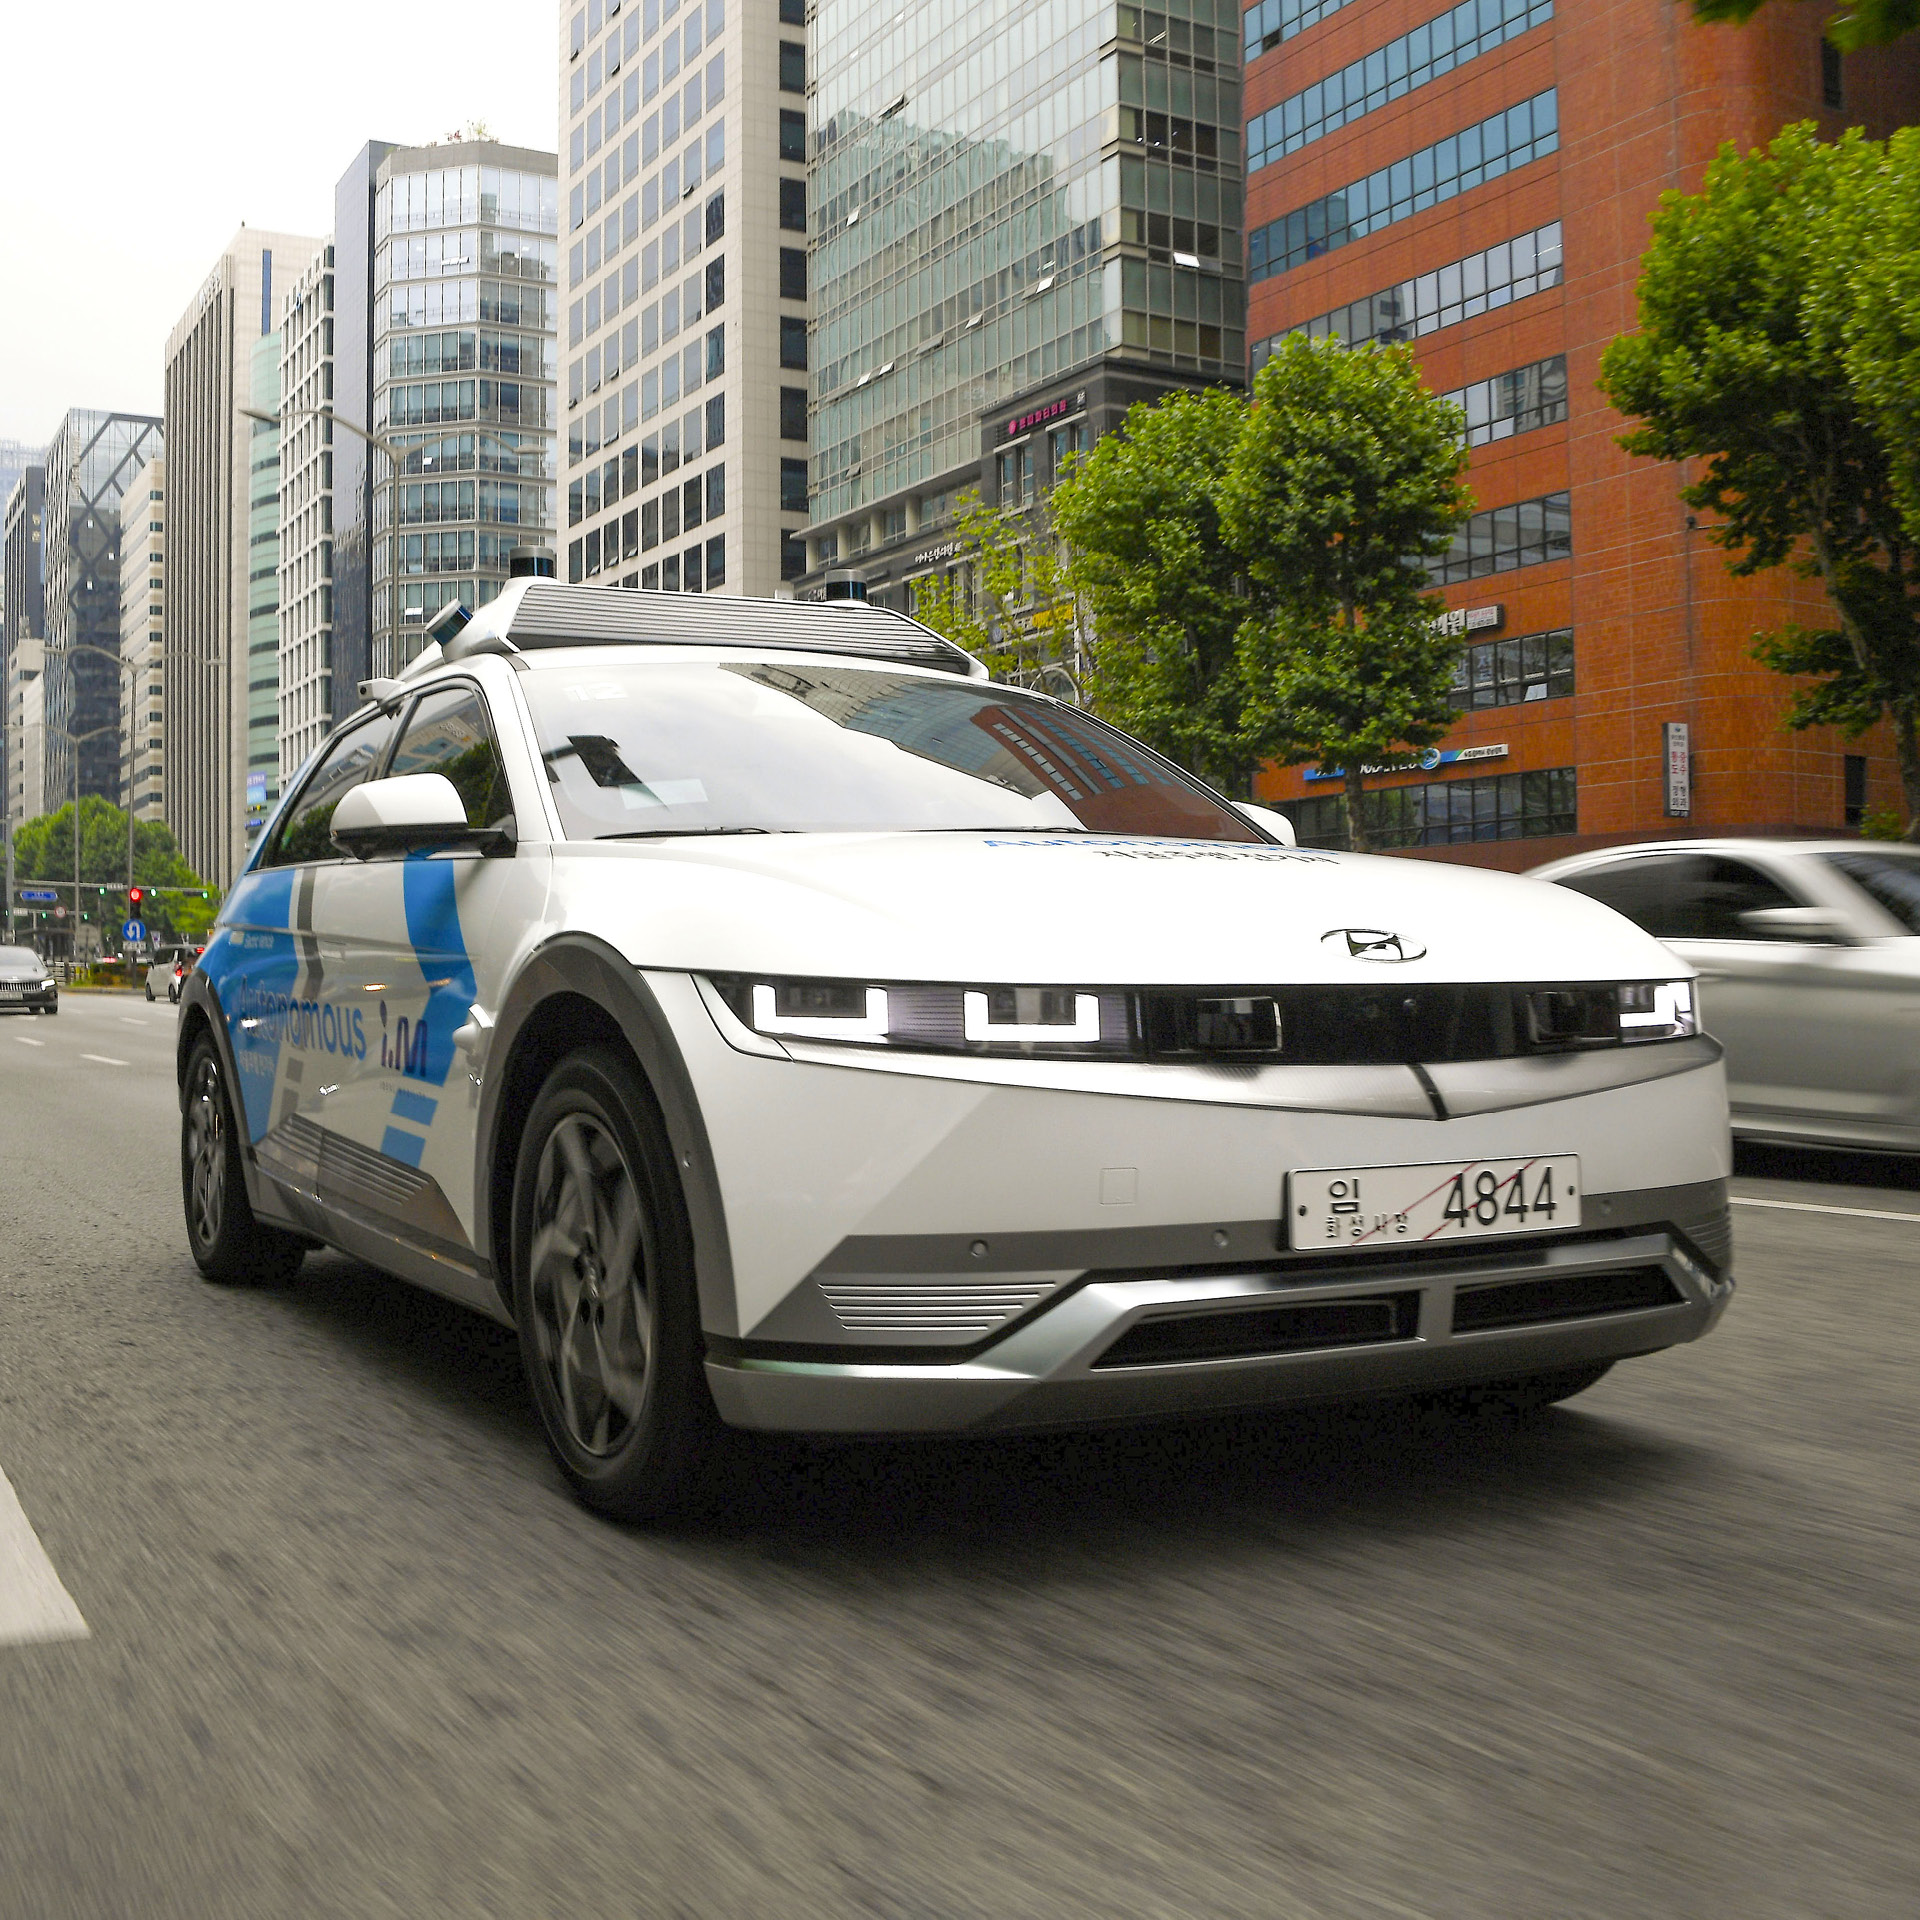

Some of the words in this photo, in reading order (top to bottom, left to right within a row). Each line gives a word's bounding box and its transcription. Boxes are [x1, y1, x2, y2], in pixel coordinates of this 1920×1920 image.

[238, 975, 366, 1061] Autonomous
[1328, 1178, 1361, 1214] 임
[1443, 1166, 1557, 1228] 4844
